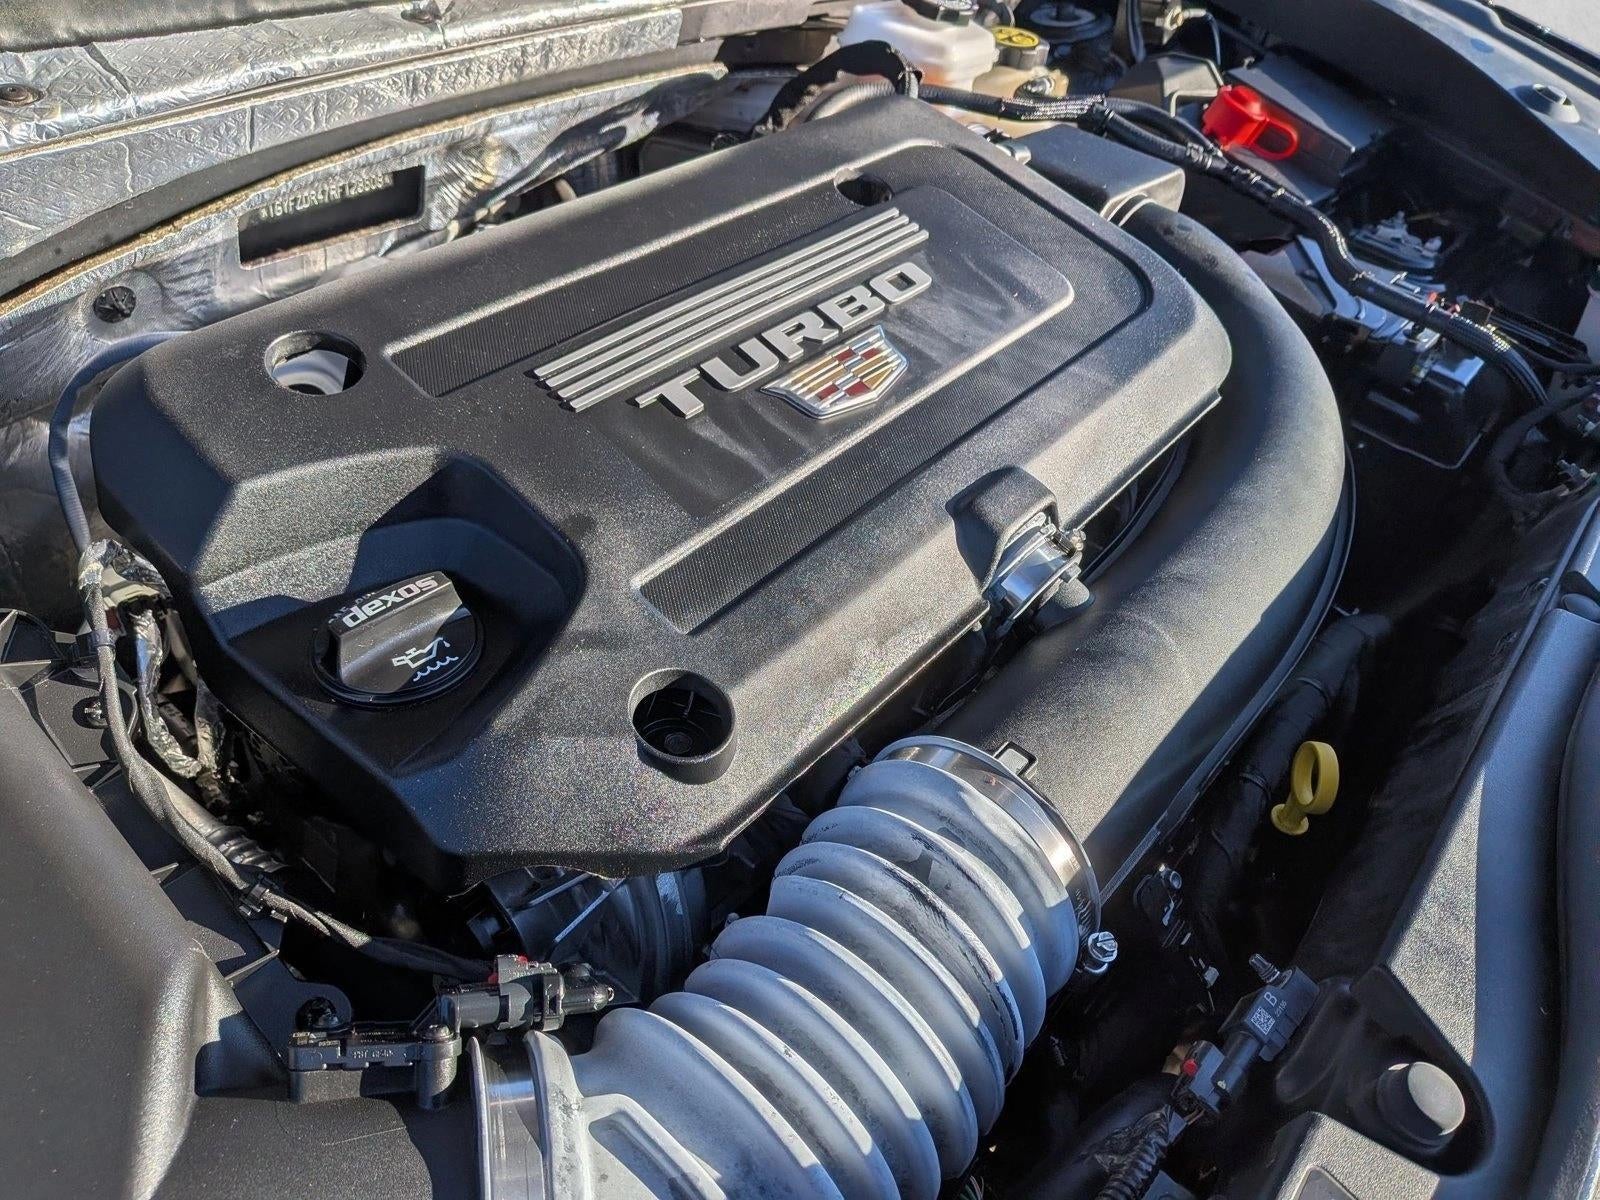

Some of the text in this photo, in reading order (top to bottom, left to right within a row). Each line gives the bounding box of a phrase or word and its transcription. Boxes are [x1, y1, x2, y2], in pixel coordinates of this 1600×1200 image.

[635, 262, 932, 419] TURBO
[342, 575, 438, 628] dexos
[1264, 991, 1277, 1007] B
